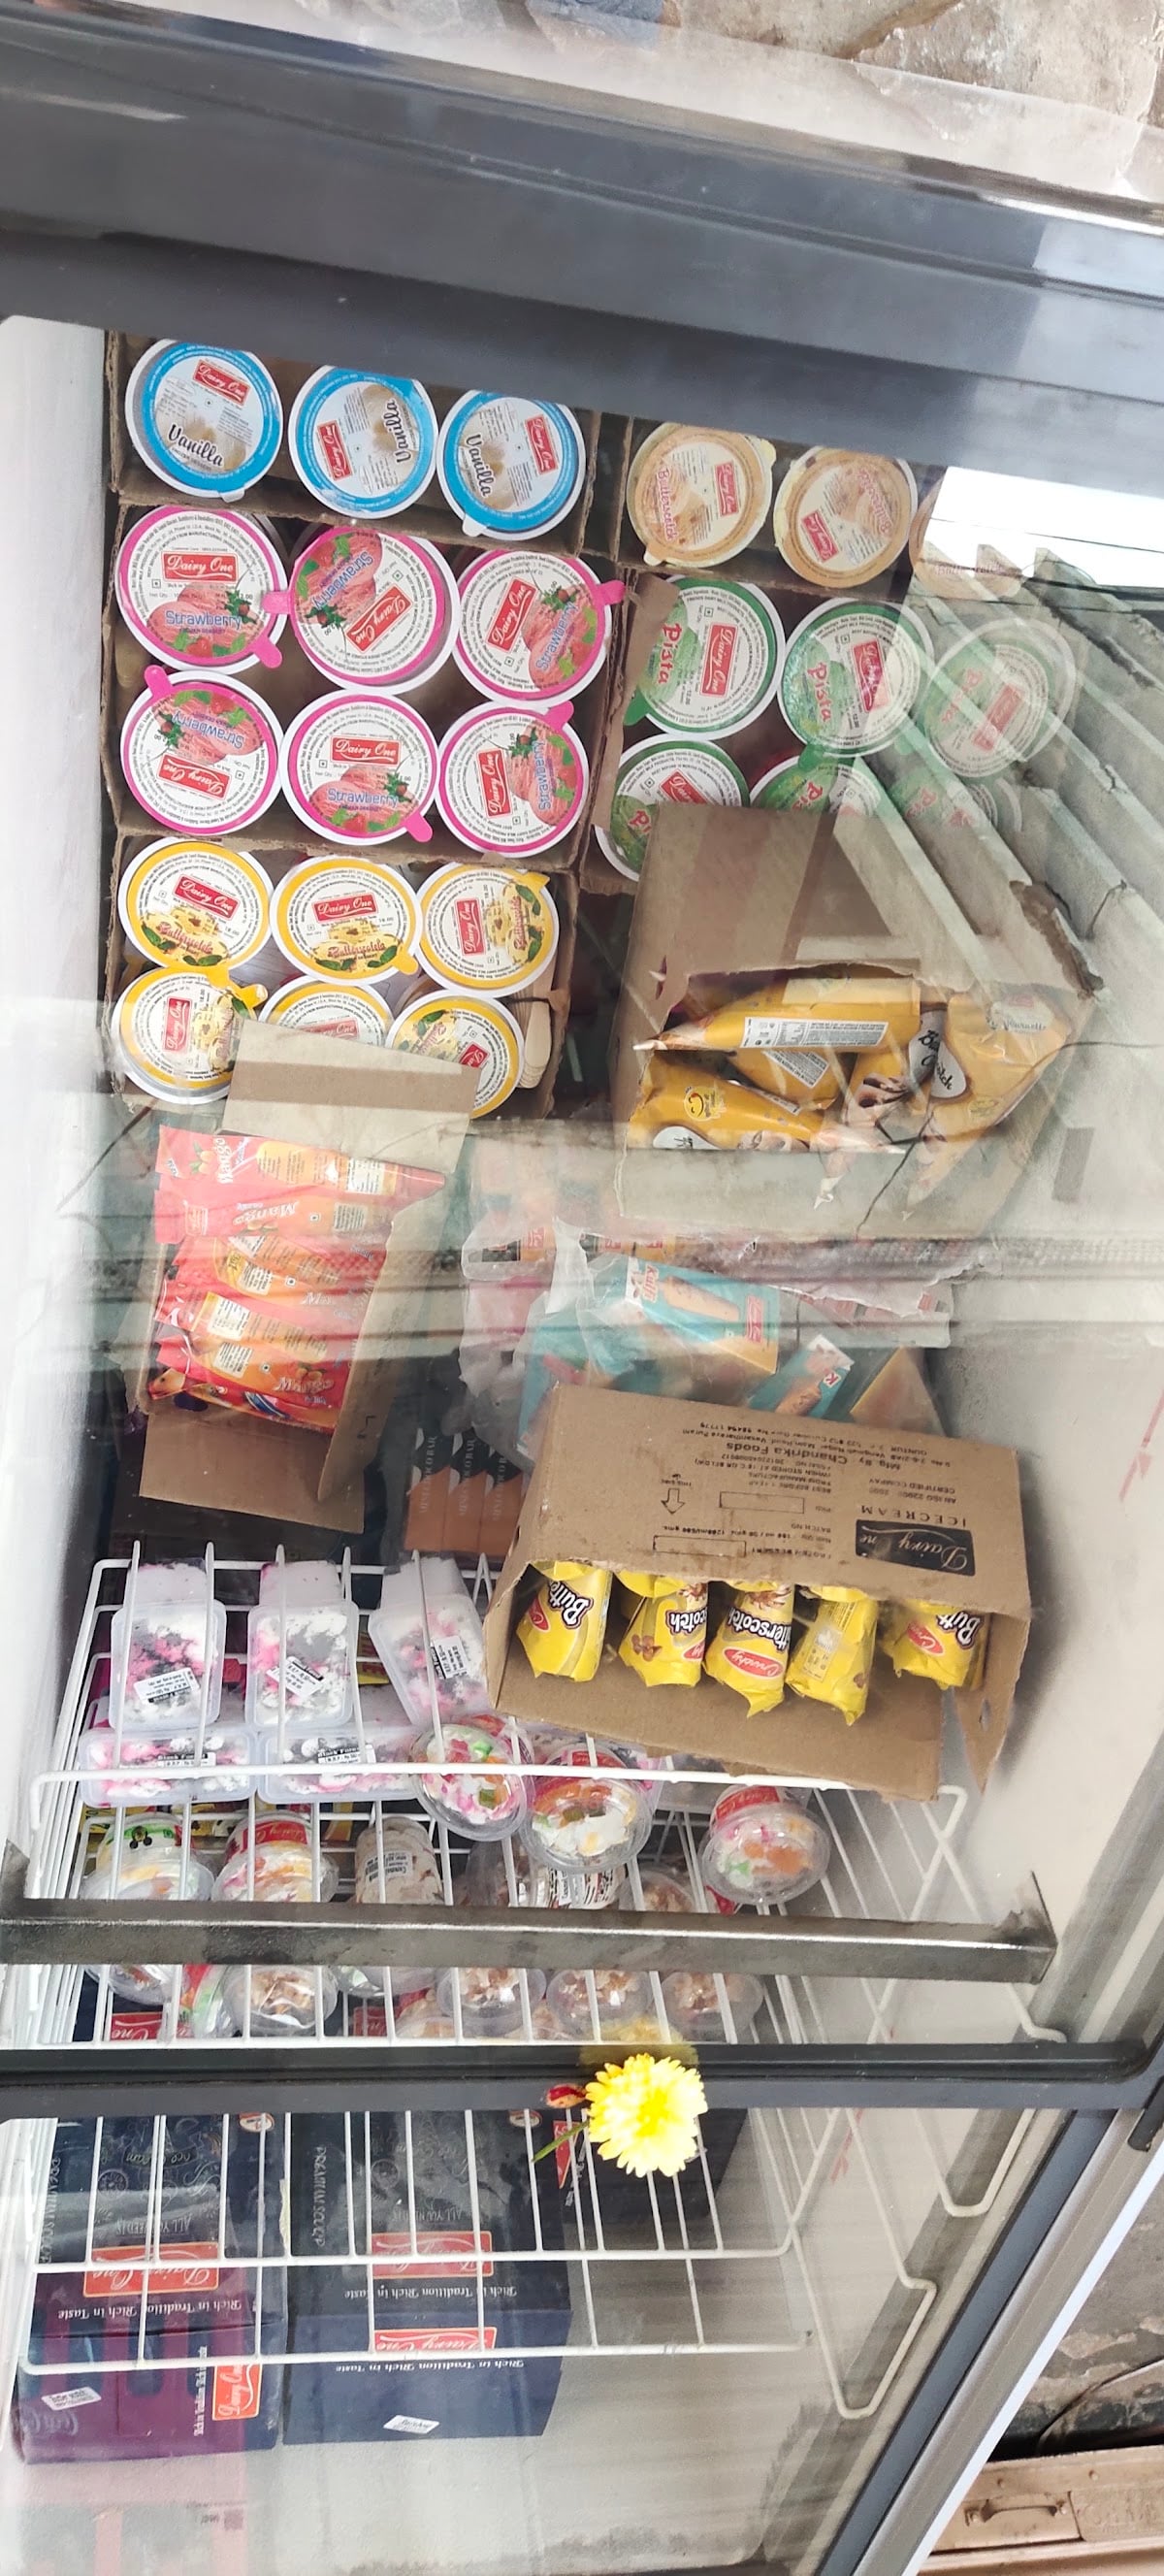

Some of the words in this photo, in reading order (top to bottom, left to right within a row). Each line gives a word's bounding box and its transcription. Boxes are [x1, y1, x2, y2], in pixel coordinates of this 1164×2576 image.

[197, 363, 226, 389] Dairy
[229, 380, 247, 398] One
[323, 424, 336, 444] One
[384, 399, 411, 464] Vanilla
[531, 417, 547, 448] Dairy
[168, 423, 224, 469] Vanilla
[331, 450, 347, 478] Dairy
[466, 434, 495, 497] Vanilla
[658, 468, 678, 541] Butterscotch
[167, 555, 207, 575] Dairy
[210, 557, 235, 573] One
[311, 550, 373, 610] Strawberry
[165, 610, 242, 631] Strawberry
[372, 597, 406, 625] Dairy
[491, 608, 518, 645] Dairy
[508, 584, 527, 607] One
[354, 627, 376, 645] One
[535, 601, 579, 672] Strawberry
[658, 623, 682, 684] Pista
[713, 629, 735, 667] Dairy
[705, 668, 727, 694] One
[807, 661, 831, 723] Pista
[171, 710, 244, 749] Strawberry
[335, 738, 372, 757] Dairy
[375, 742, 397, 757] One
[163, 764, 185, 782] One
[482, 753, 497, 775] One
[188, 770, 225, 796] Dairy
[533, 741, 552, 811] Strawberry
[327, 787, 400, 809] Strawberry
[488, 776, 504, 815] Dairy
[180, 879, 212, 903] Dairy
[213, 895, 233, 912] One
[317, 903, 351, 917] Dairy
[352, 897, 372, 909] One
[460, 901, 472, 921] One
[463, 922, 476, 953] Dairy
[213, 1137, 234, 1184] Mango
[232, 1200, 301, 1224] Mango
[643, 1264, 659, 1303] Kulfi
[274, 1376, 335, 1394] Mango
[727, 1442, 769, 1455] Foods
[774, 1447, 848, 1465] Chandrika
[909, 1482, 955, 1495] CERTIFIED
[861, 1505, 967, 1528] ICECREAM
[898, 1530, 968, 1571] Dairy
[730, 1648, 781, 1678] Crunchy
[344, 2289, 370, 2299] aste
[391, 2286, 420, 2299] Rich
[422, 2286, 474, 2299] Tradition
[490, 2286, 518, 2298] Rich
[57, 2309, 90, 2320] Taste
[93, 2307, 106, 2319] in
[106, 2305, 138, 2319] Rich
[146, 2301, 196, 2317] Traditio
[197, 2302, 211, 2313] in
[216, 2299, 242, 2312] Rich
[335, 2364, 366, 2373] Taste
[385, 2363, 415, 2371] Rich
[418, 2362, 475, 2370] Tradition
[497, 2360, 525, 2368] Rich
